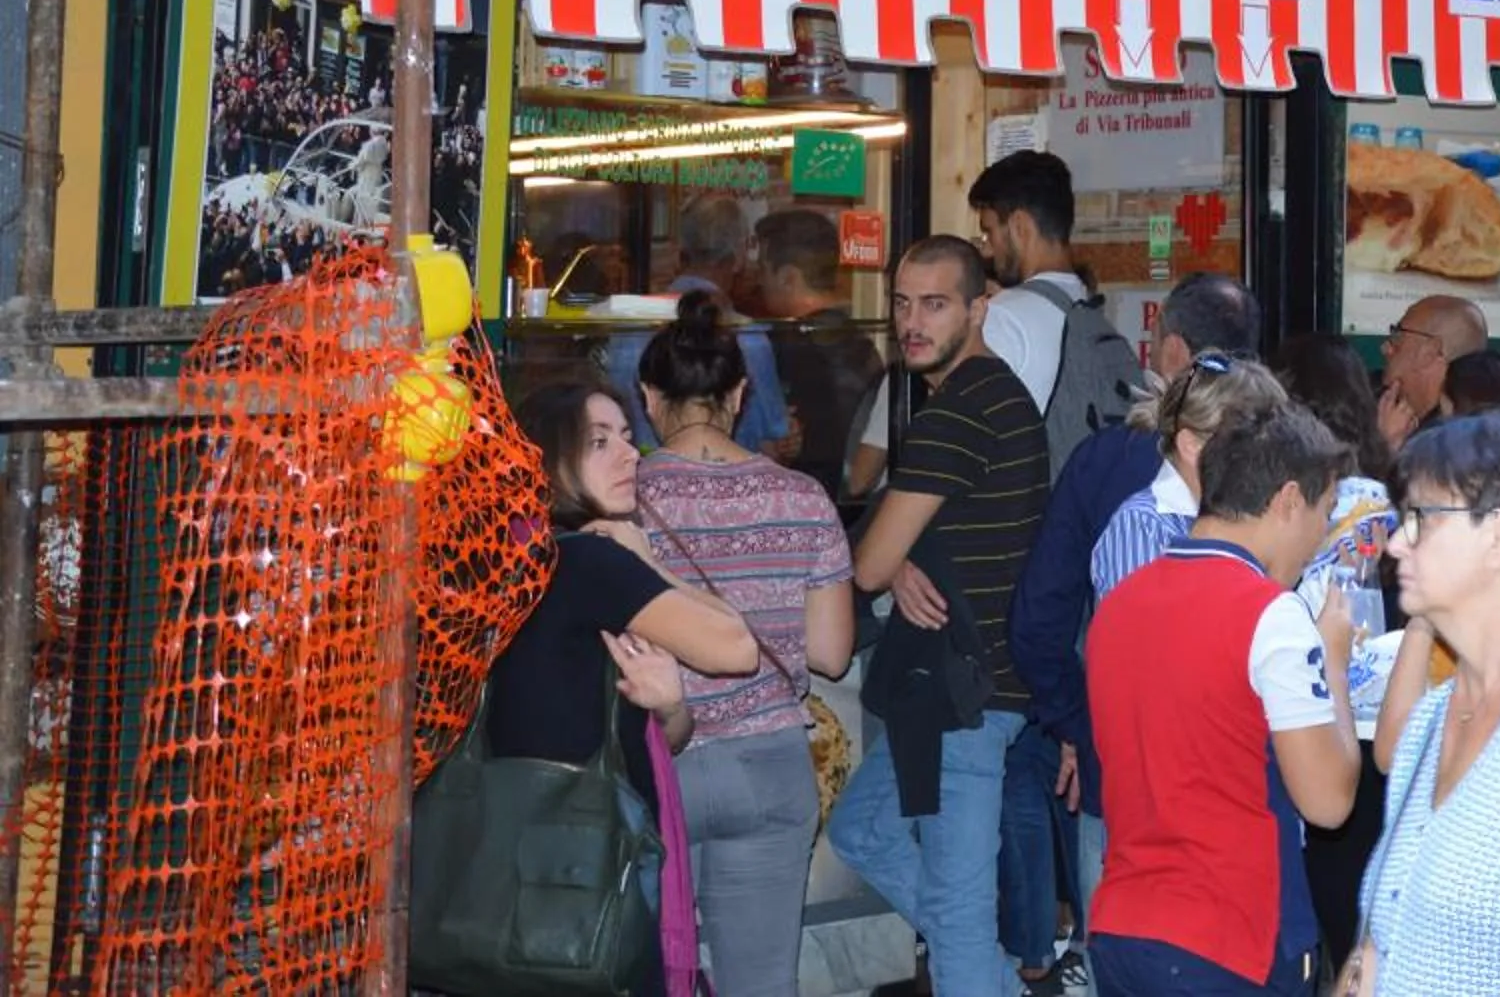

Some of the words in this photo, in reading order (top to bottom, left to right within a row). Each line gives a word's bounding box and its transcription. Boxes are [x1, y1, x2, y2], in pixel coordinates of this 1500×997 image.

[1059, 92, 1077, 110] La
[1085, 88, 1139, 108] Pizzeria
[1171, 82, 1215, 102] antica
[1075, 117, 1090, 135] di
[1097, 115, 1121, 134] Via
[1124, 109, 1192, 133] Tribunali
